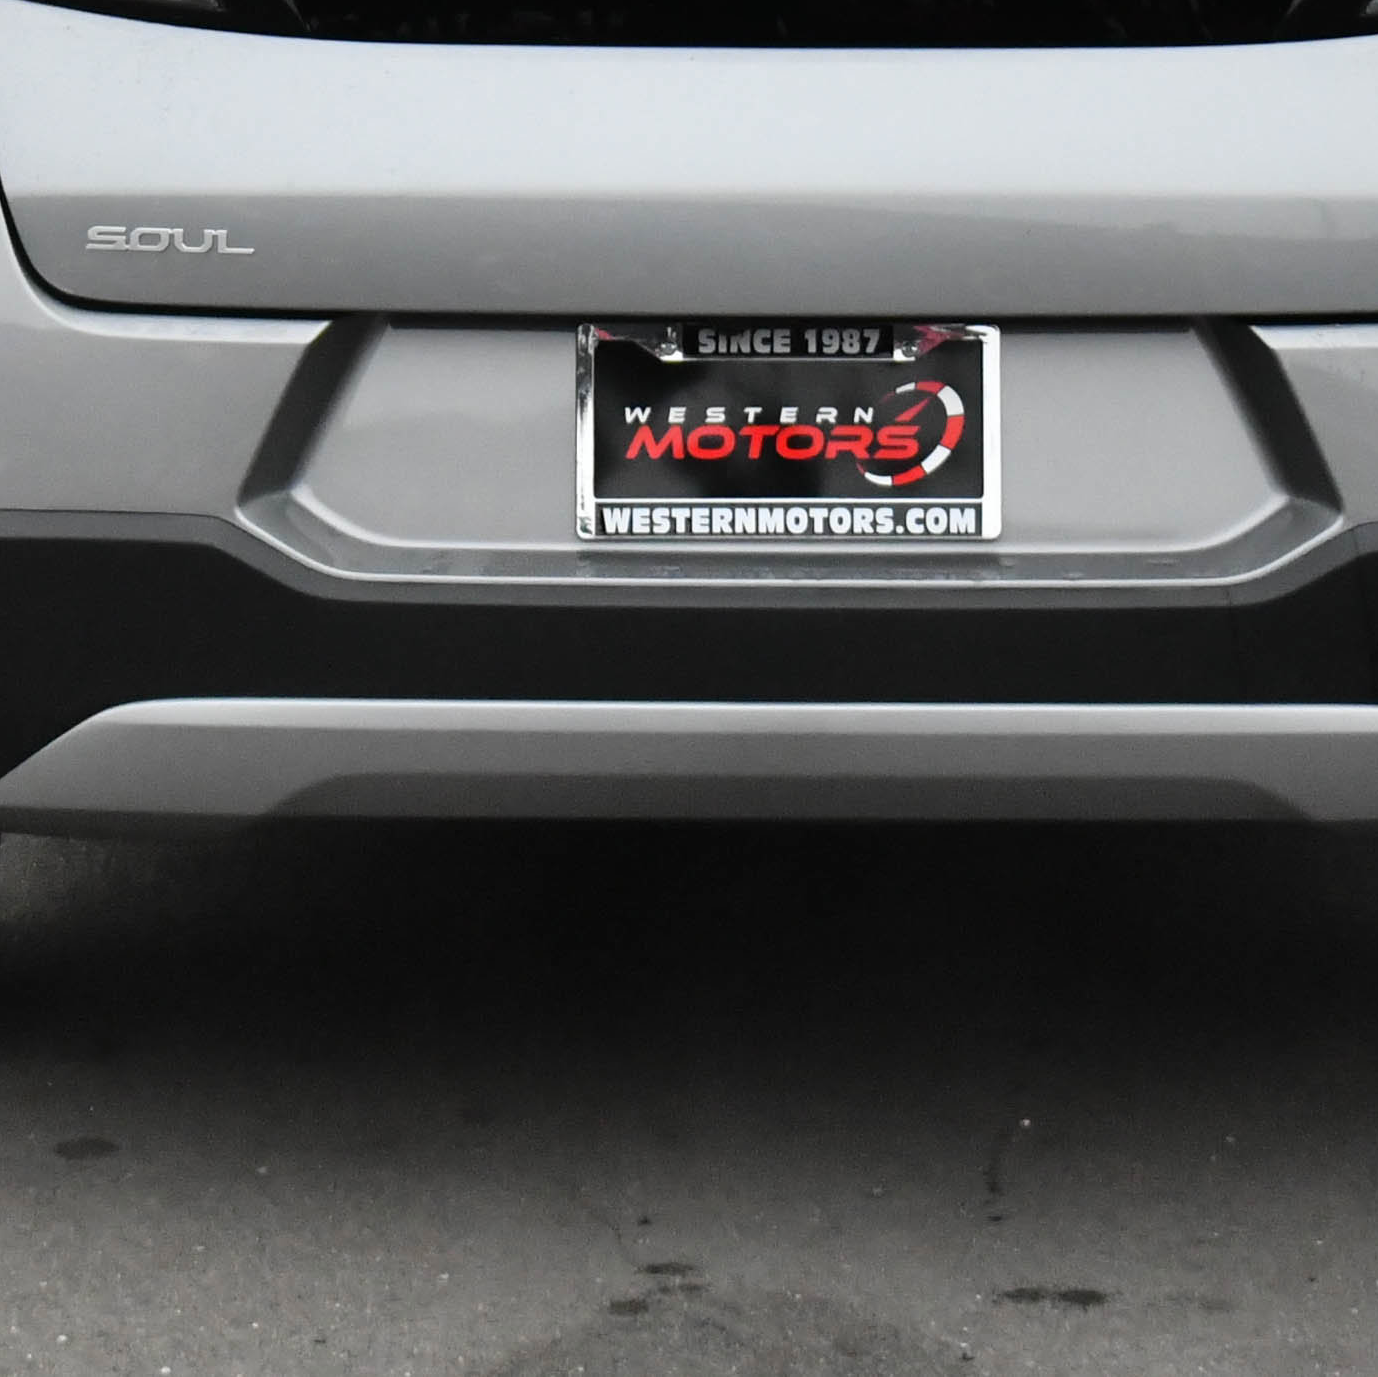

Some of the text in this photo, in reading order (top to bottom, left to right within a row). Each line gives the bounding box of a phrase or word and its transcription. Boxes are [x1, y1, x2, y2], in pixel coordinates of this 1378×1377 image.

[85, 225, 256, 255] SOUL
[698, 328, 881, 355] SINCE 1987
[624, 406, 875, 425] WESTERN
[625, 424, 921, 460] MOTORS
[601, 506, 976, 535] WESTERNMOTORS.COM
